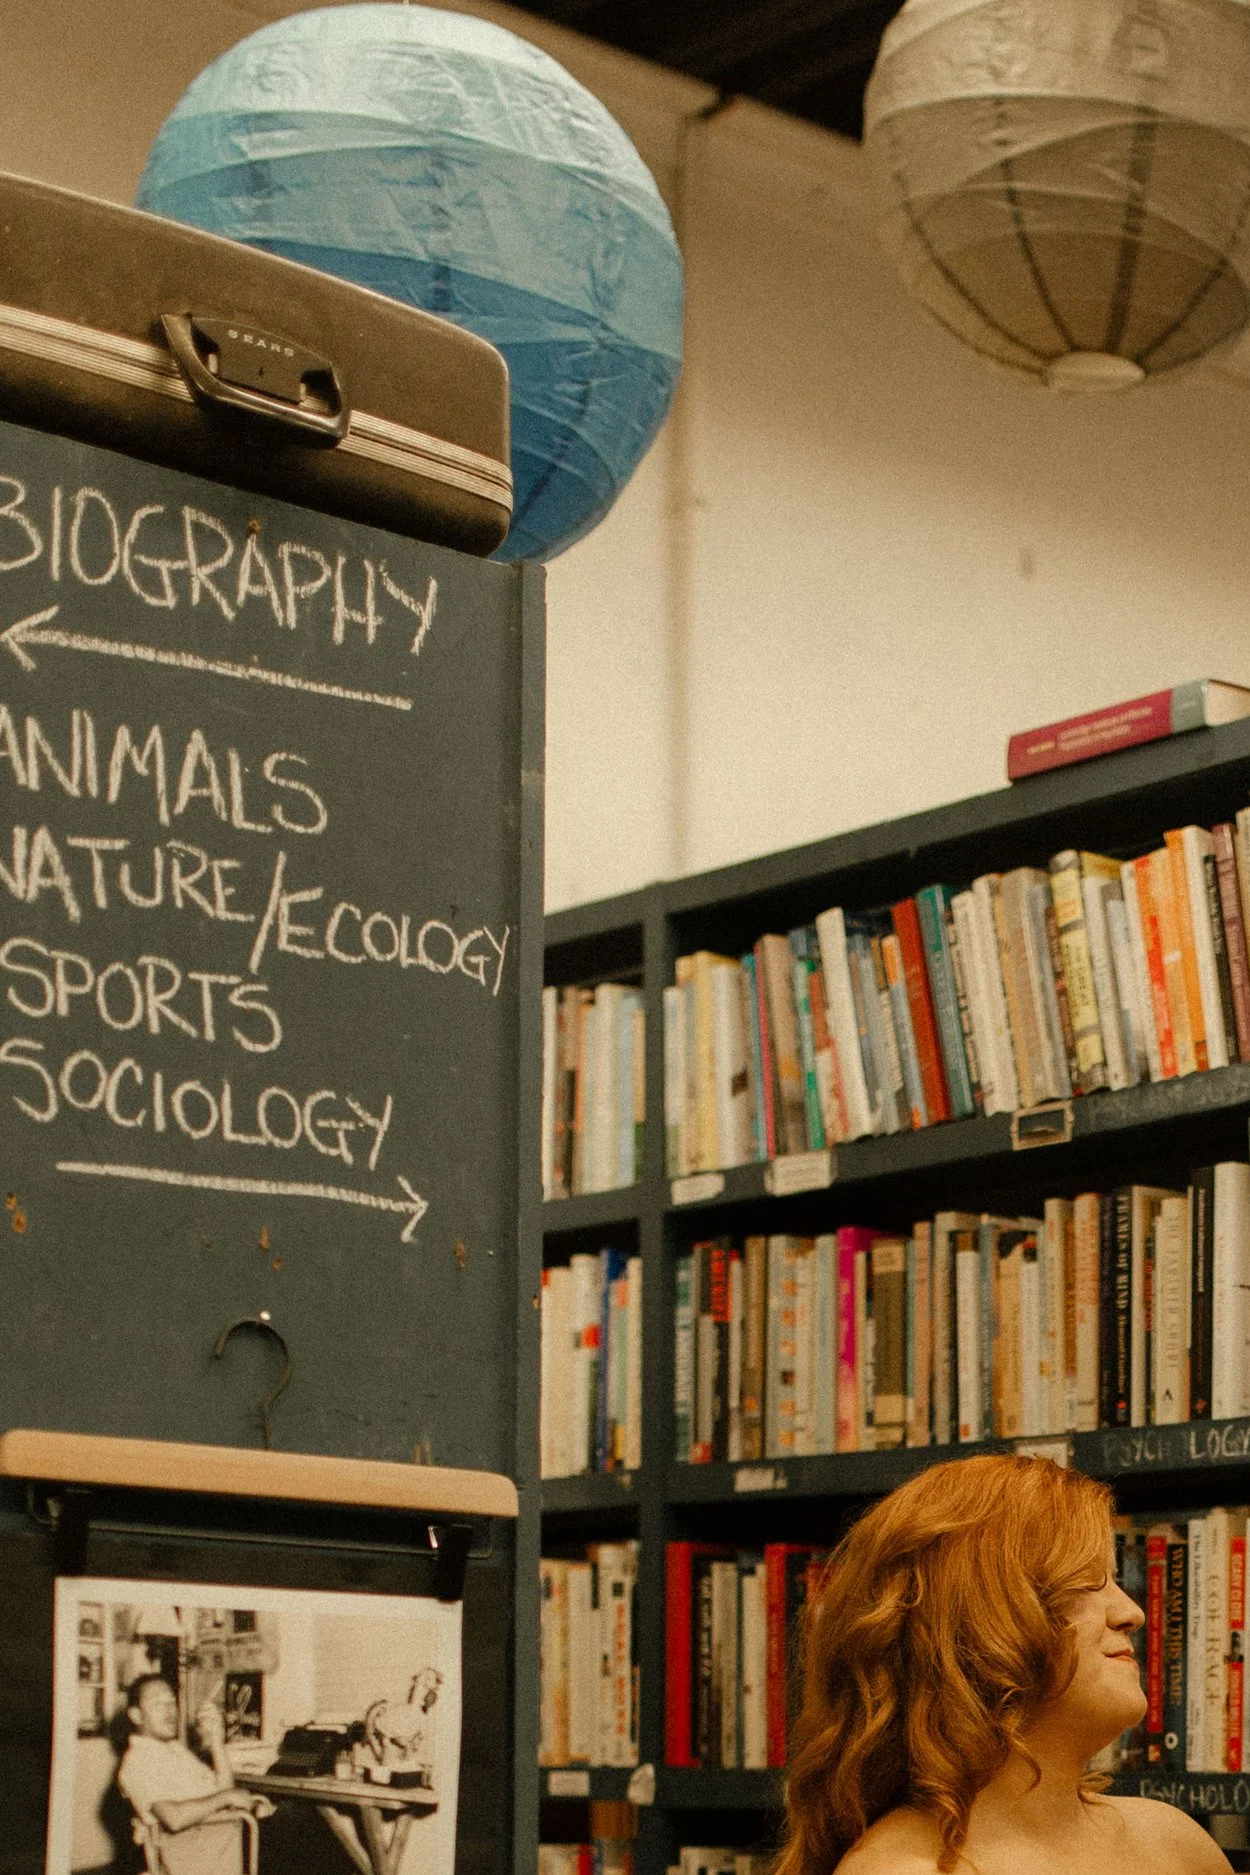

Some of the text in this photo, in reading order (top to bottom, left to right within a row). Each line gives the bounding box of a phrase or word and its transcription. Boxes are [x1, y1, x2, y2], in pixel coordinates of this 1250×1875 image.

[1, 938, 283, 1052] SPORTS
[0, 1038, 392, 1170] SOCIOLOGY
[1117, 1195, 1128, 1249] FRAMES
[1118, 1253, 1128, 1270] OF
[1117, 1274, 1129, 1309] MIND
[1172, 1547, 1184, 1586] WHO
[1233, 1553, 1242, 1588] SCARY
[1171, 1590, 1182, 1613] AM
[1170, 1627, 1181, 1659] THIS
[1169, 1662, 1181, 1705] TIME?
